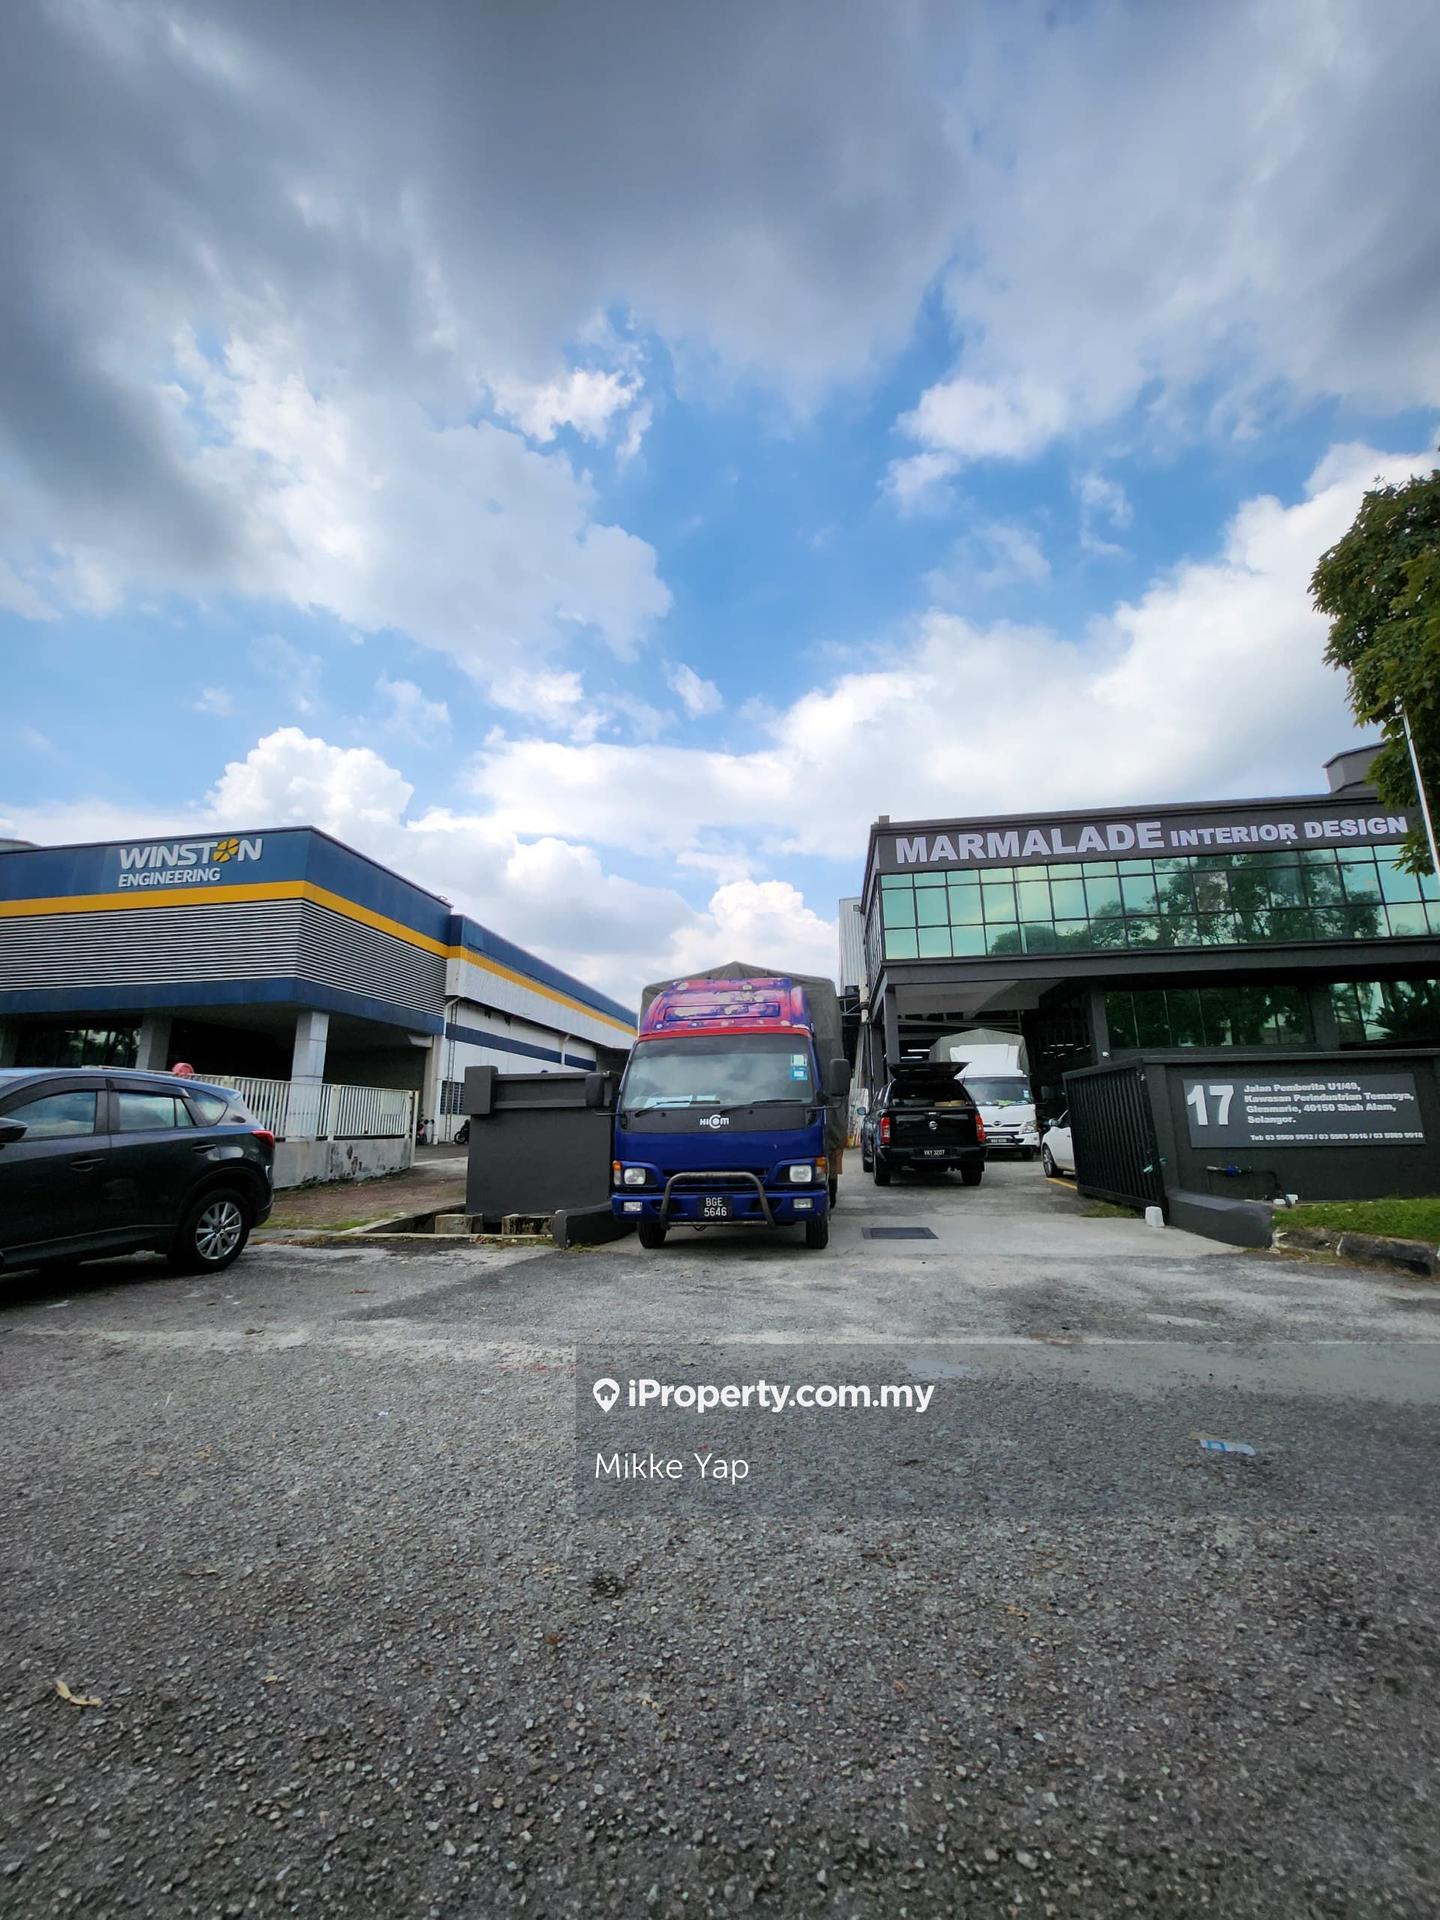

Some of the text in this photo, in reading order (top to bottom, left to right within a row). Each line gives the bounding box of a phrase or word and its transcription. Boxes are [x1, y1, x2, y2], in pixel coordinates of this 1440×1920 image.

[895, 816, 1409, 864] MARMALADE INTERIOR DESIGN
[118, 867, 221, 888] ENGINEERING
[1244, 1085, 1272, 1093] Jalan
[1273, 1083, 1326, 1092] Pemberita
[1244, 1095, 1292, 1103] Kawasan
[1293, 1093, 1362, 1102] Perindustrian
[1187, 1084, 1235, 1127] 17
[1246, 1103, 1397, 1114] Glenmarie, 40150 Shah Alam,
[1247, 1116, 1296, 1125] Selangor.
[705, 1196, 724, 1207] BGE
[703, 1206, 728, 1217] 5646
